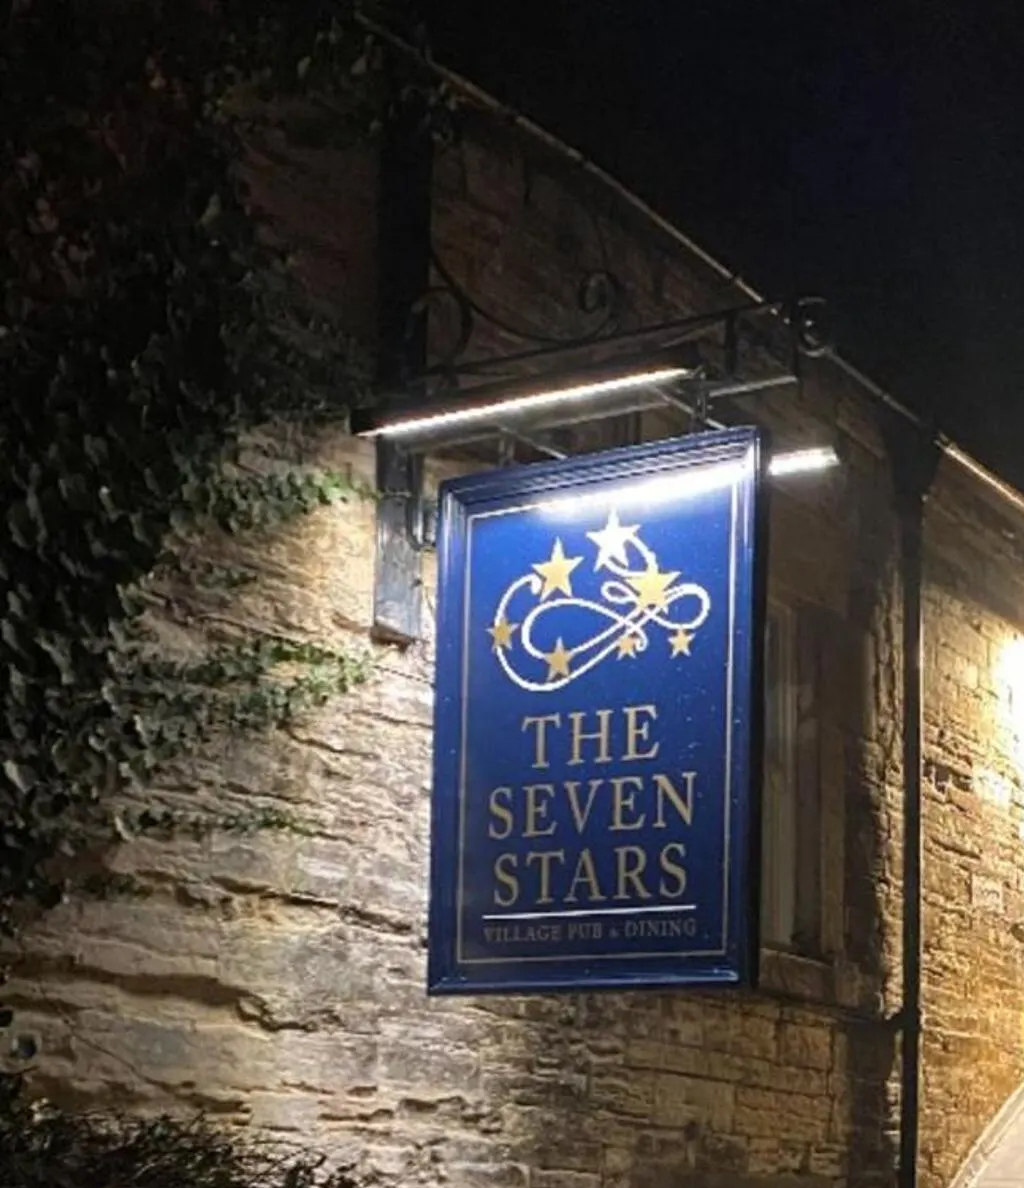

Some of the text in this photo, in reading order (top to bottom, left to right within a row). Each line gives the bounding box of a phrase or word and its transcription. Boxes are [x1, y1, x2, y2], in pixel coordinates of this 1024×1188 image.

[521, 703, 659, 769] THE
[487, 771, 696, 839] SEVEN
[493, 842, 686, 906] STARS
[483, 924, 561, 942] VILLAGE
[567, 922, 602, 939] PUB
[623, 917, 696, 938] DINING
